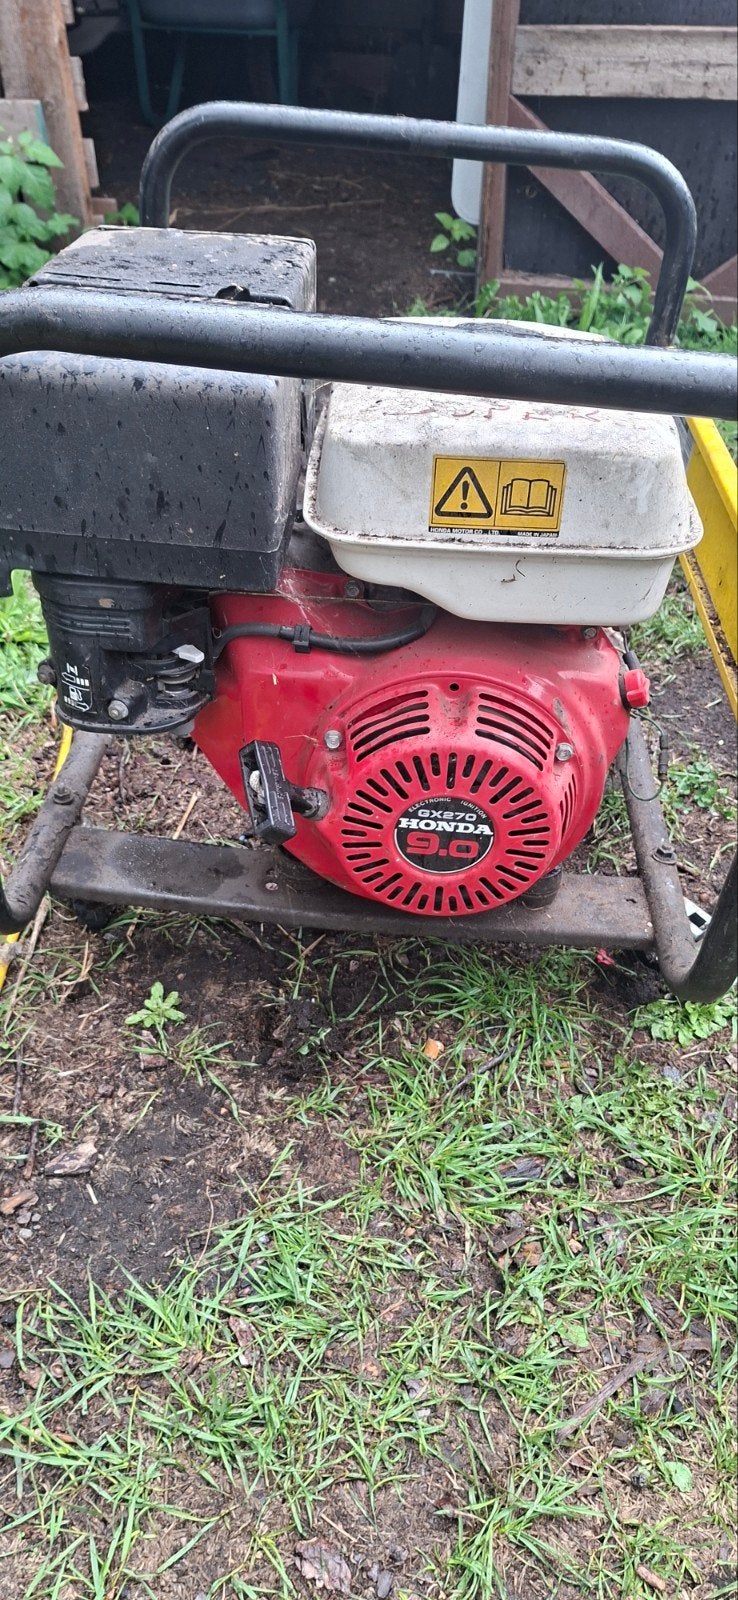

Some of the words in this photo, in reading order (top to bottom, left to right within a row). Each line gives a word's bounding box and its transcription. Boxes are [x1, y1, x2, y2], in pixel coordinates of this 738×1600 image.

[408, 797, 452, 813] ELECTRONIC
[460, 800, 488, 819] IGNITION
[417, 809, 477, 822] GX270
[398, 817, 494, 835] HONDA
[406, 831, 480, 859] 9.0
